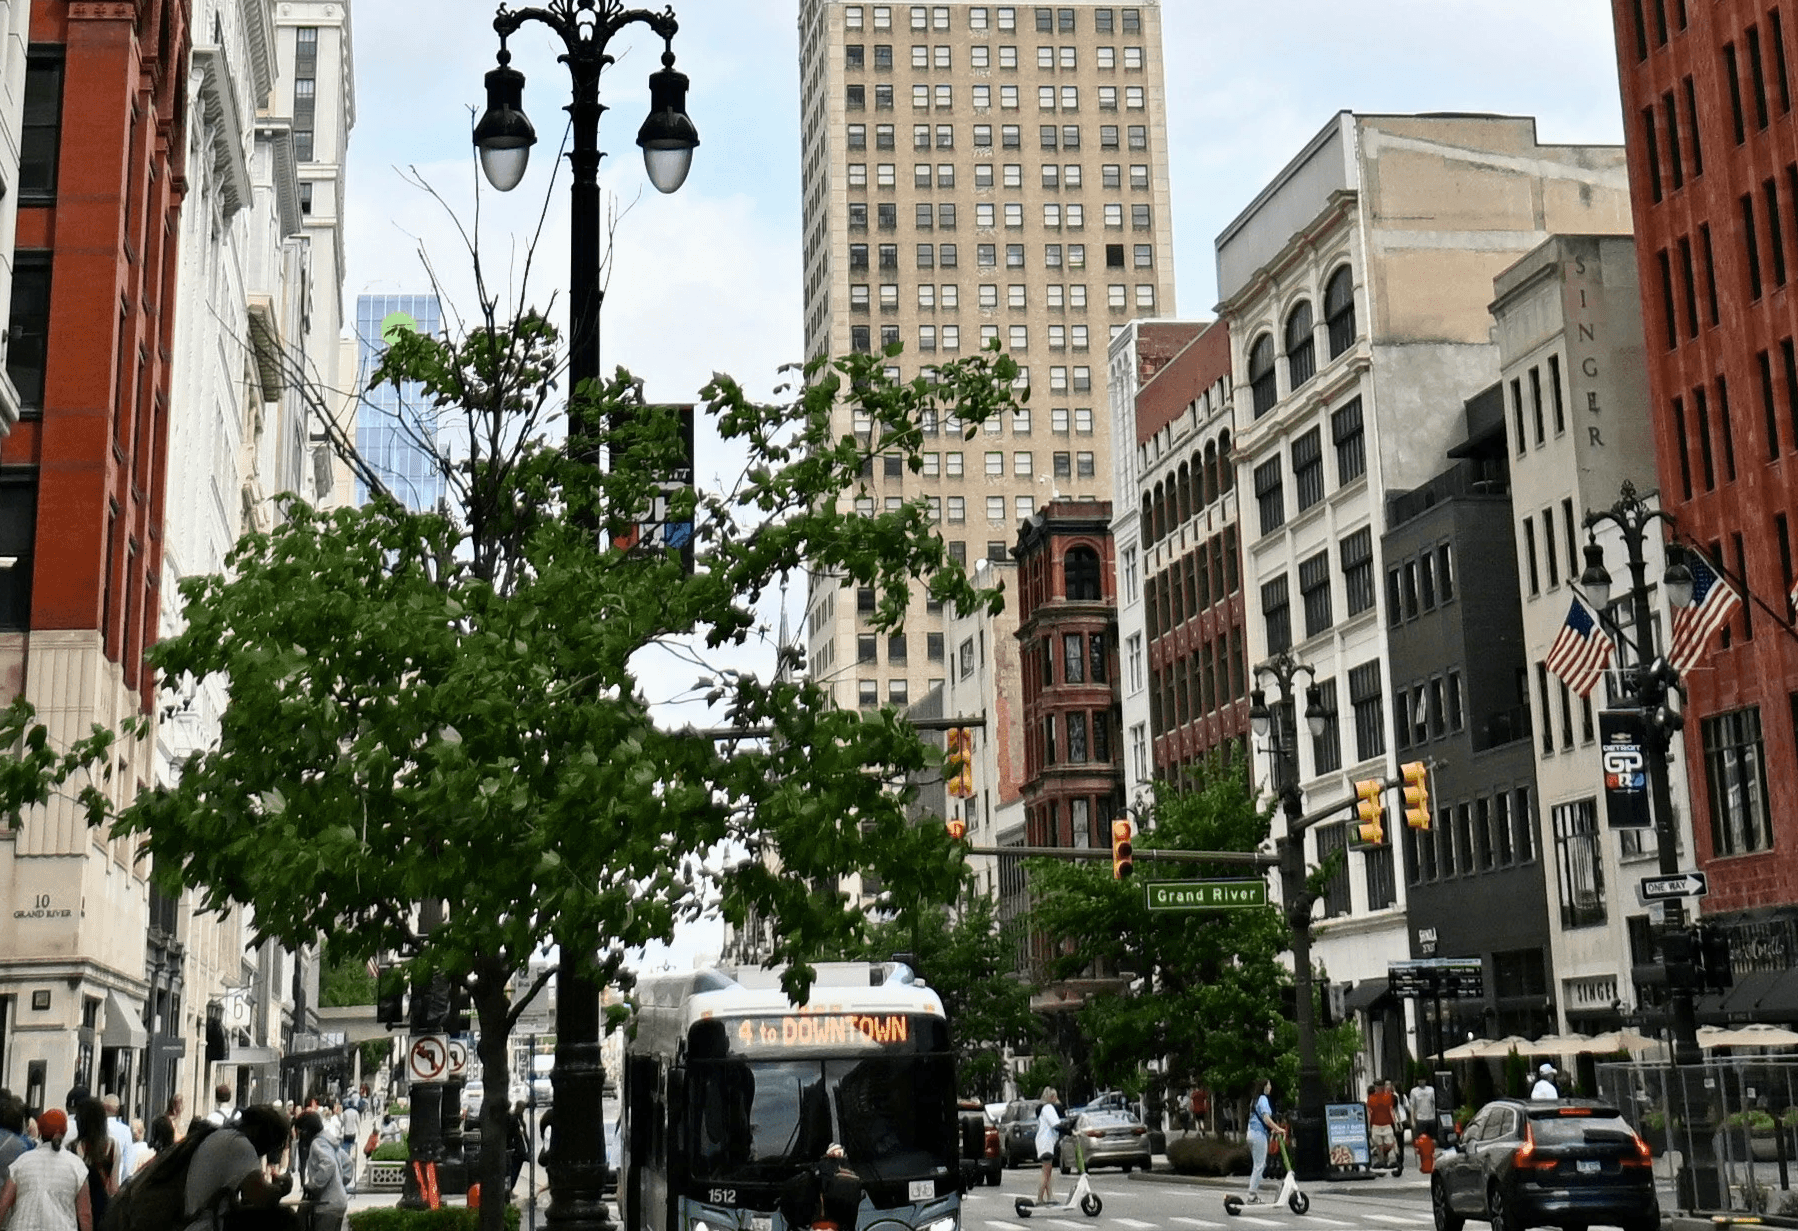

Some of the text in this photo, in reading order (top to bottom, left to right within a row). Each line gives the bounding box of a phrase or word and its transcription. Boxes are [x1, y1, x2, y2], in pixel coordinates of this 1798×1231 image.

[1574, 253, 1605, 447] SINGER
[1604, 751, 1644, 773] GP
[1157, 886, 1256, 902] Grand River
[1647, 881, 1687, 892] ONE WAY
[35, 894, 51, 909] 10
[13, 909, 72, 919] GRAND RIVER
[233, 994, 245, 1020] 6
[738, 1015, 907, 1046] 4 to DOWNTOWN
[708, 1187, 737, 1204] 1512
